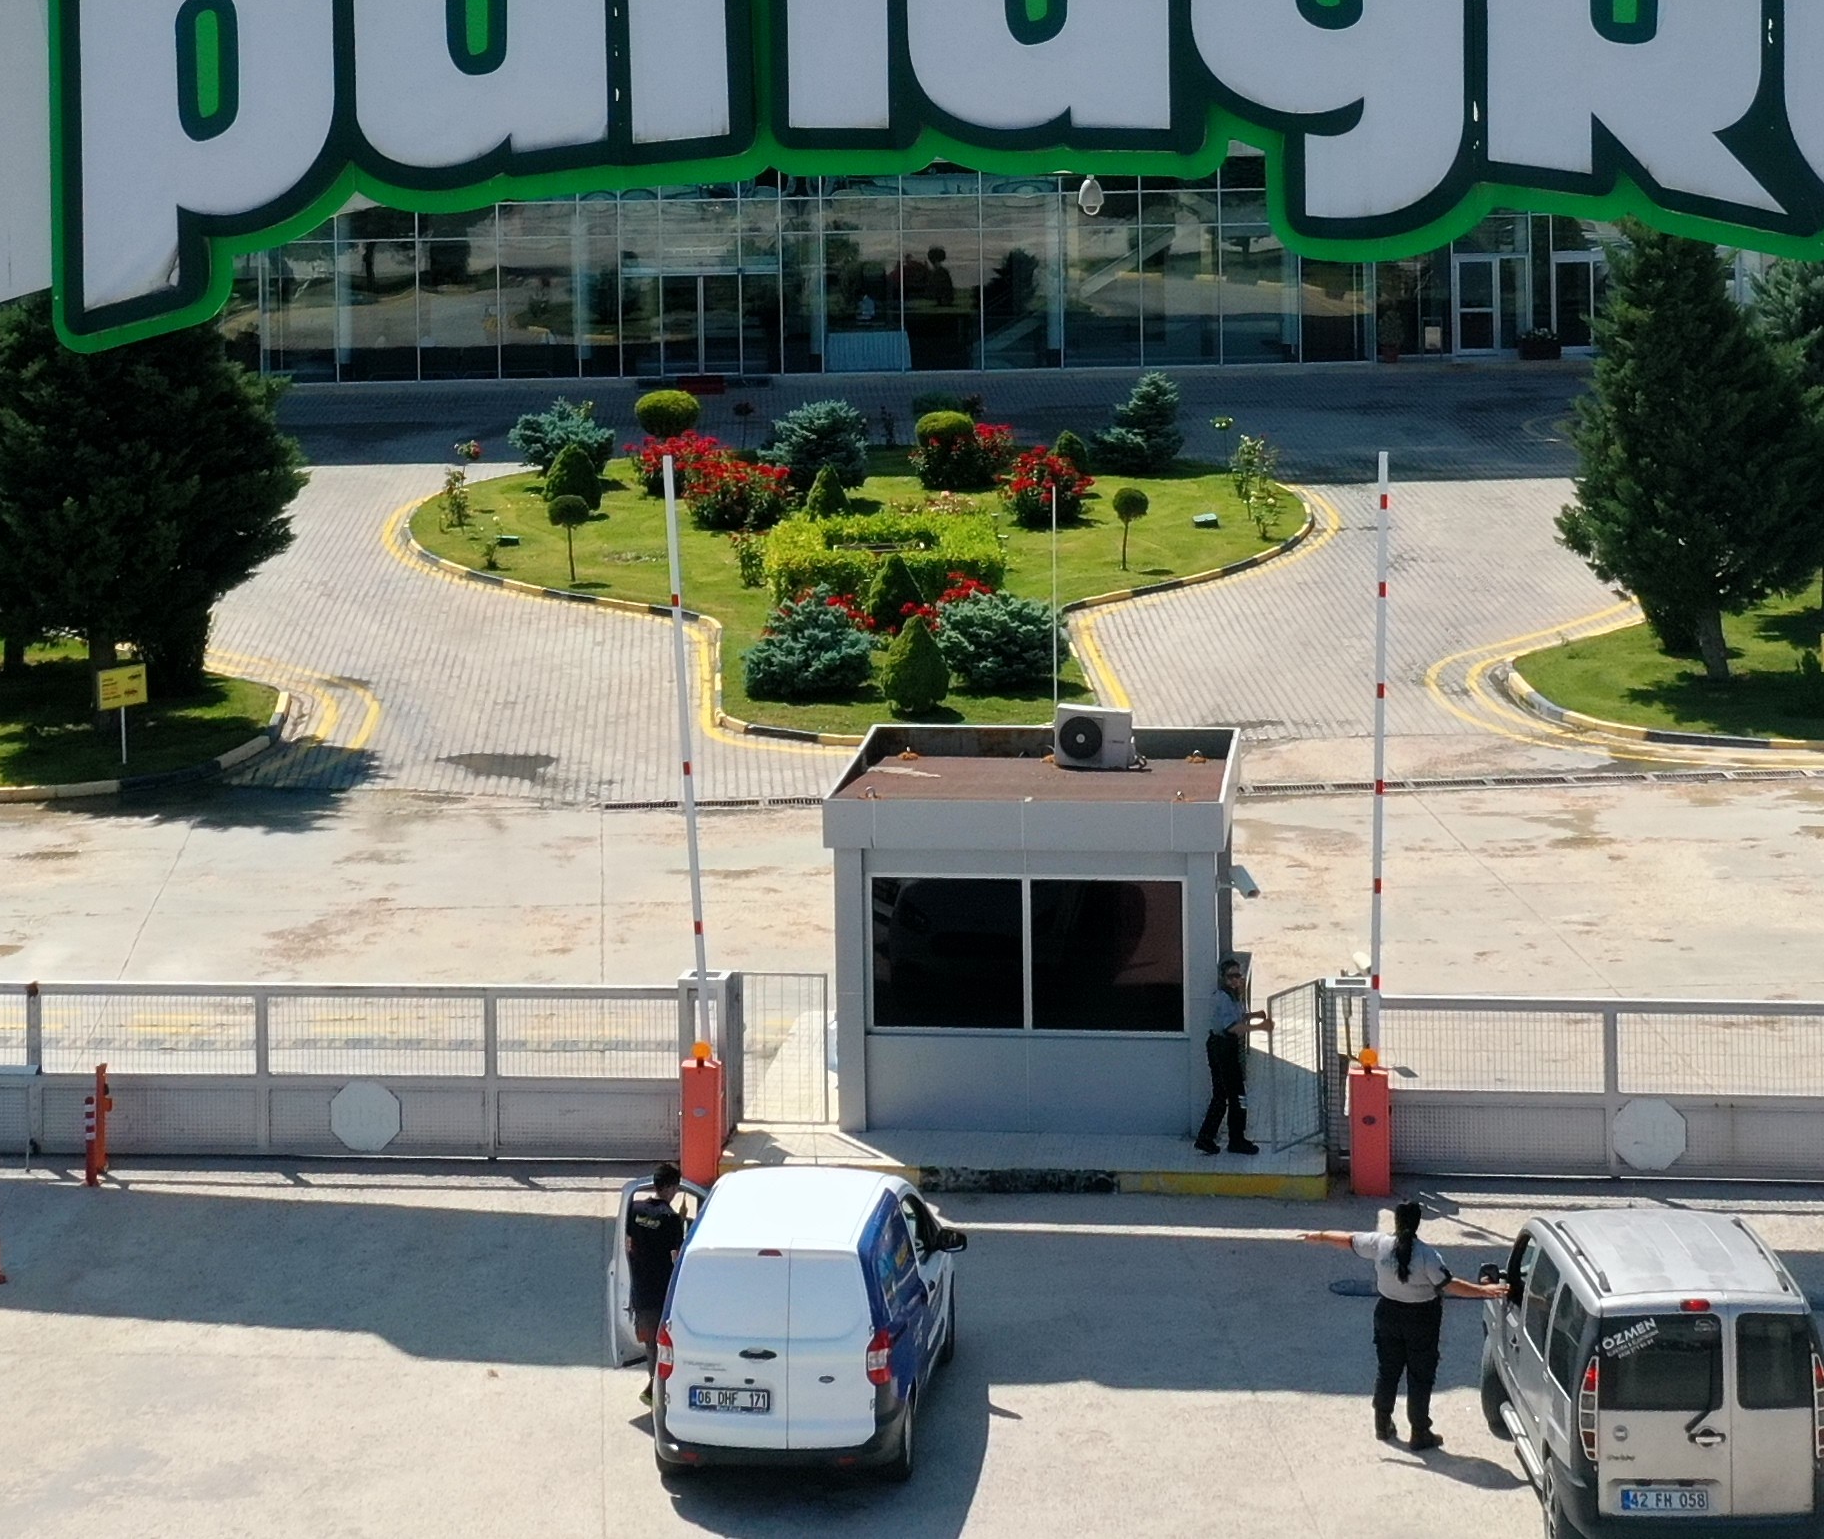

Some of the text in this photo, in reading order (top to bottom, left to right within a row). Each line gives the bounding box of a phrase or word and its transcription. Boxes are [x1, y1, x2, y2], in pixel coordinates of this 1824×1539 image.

[1602, 1317, 1657, 1350] ÖZMEN
[697, 1389, 767, 1408] 06 DHF 171
[1631, 1492, 1706, 1508] 42 FH 058
